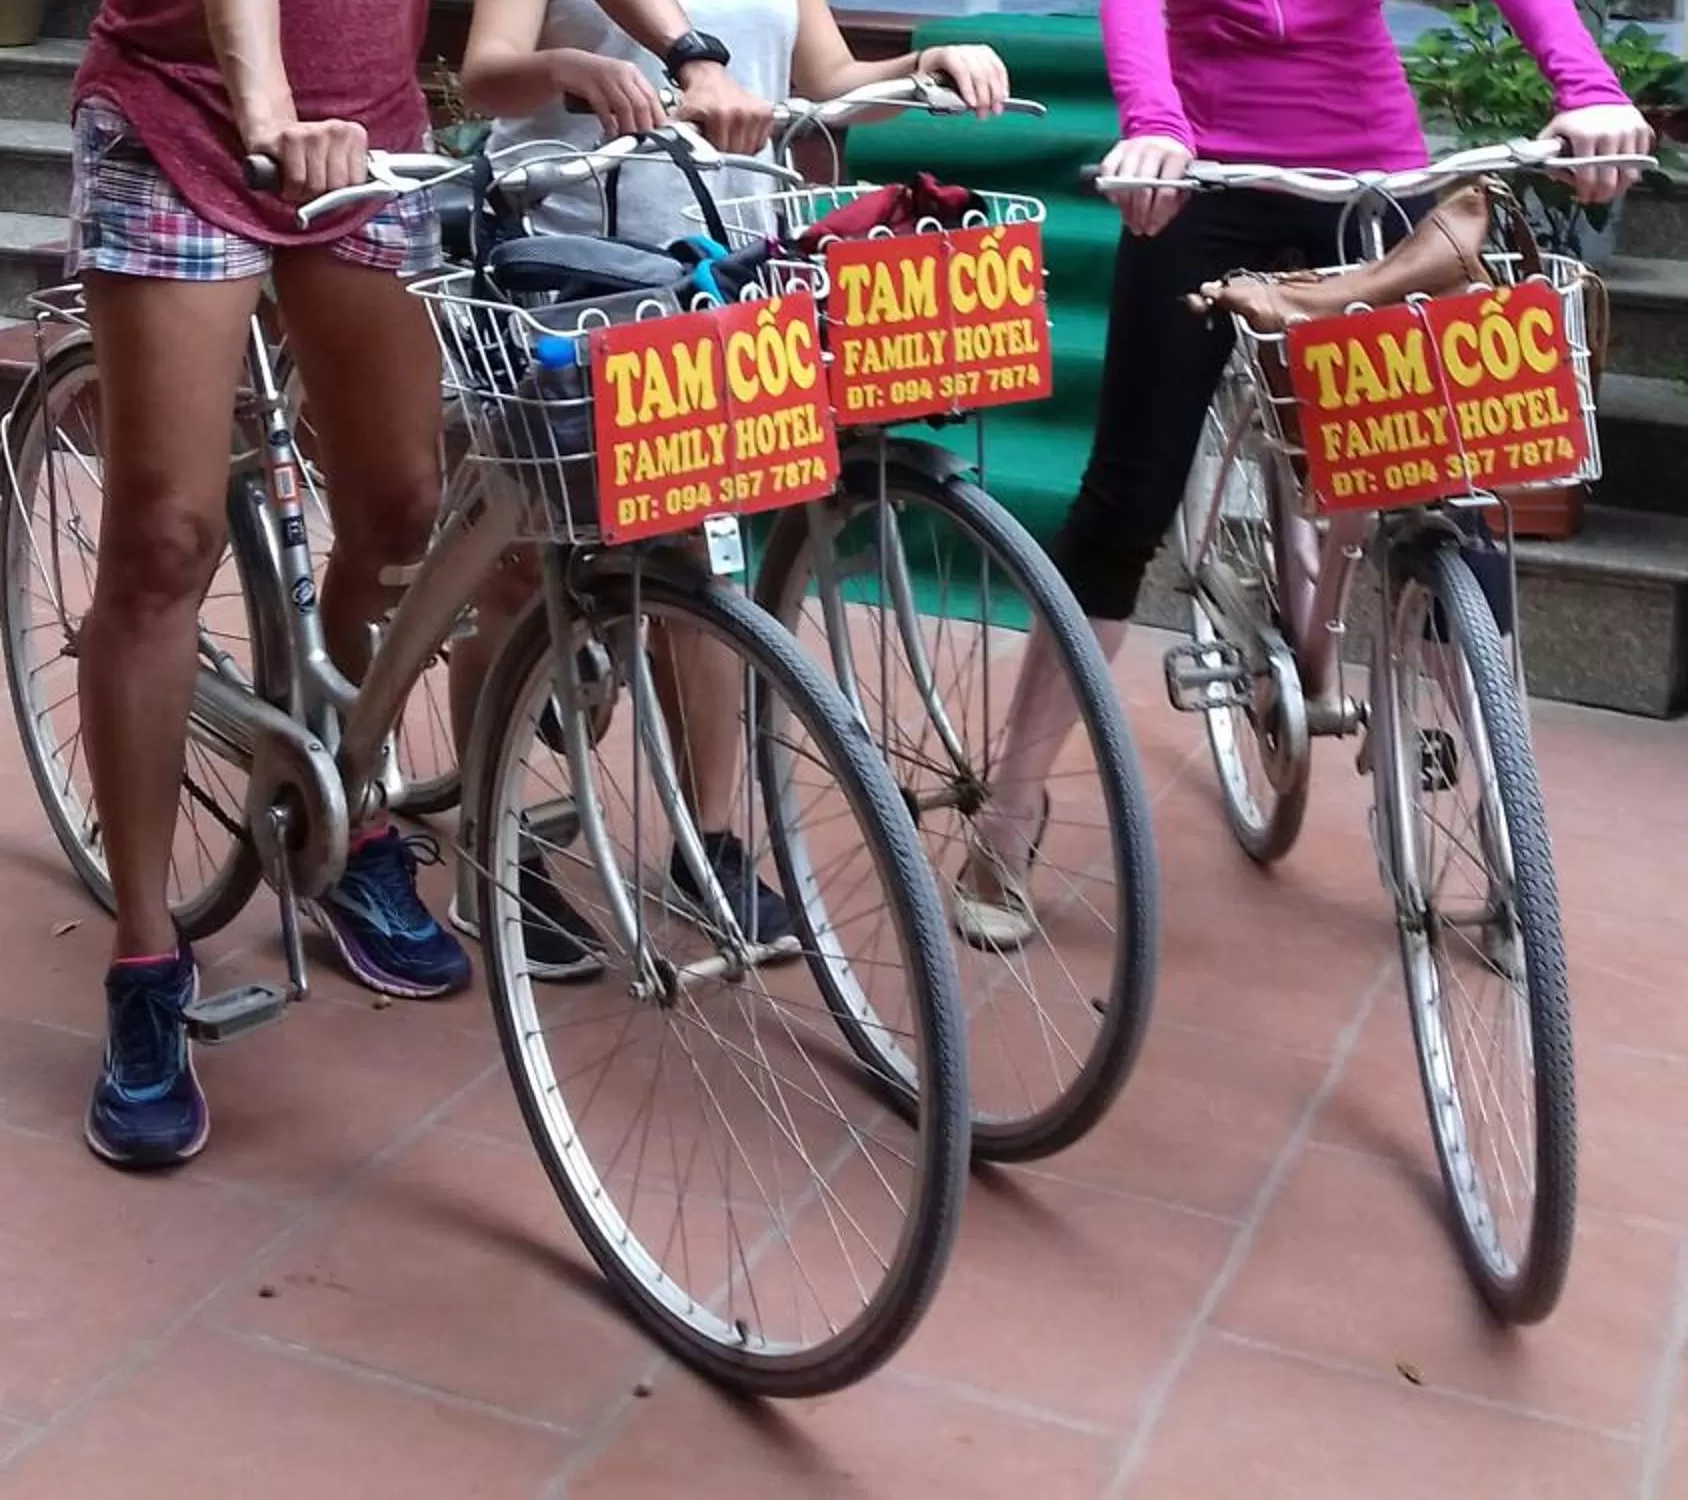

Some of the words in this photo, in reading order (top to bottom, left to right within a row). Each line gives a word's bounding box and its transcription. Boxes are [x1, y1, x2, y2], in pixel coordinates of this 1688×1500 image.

[838, 256, 939, 327] TAM
[948, 226, 1035, 313] CỐC
[605, 338, 717, 428] TAM
[725, 297, 816, 403] CỐC
[843, 330, 947, 377] FAMILY
[954, 318, 1040, 362] HOTEL
[890, 378, 933, 405] 094
[939, 372, 981, 398] 367
[985, 364, 1040, 391] 7874
[1304, 328, 1434, 409] TAM
[1442, 287, 1558, 388] CỐC
[613, 424, 727, 487] FAMILY
[735, 404, 824, 461] HOTEL
[1320, 405, 1448, 461] FAMILY
[1457, 386, 1569, 441] HOTEL
[666, 482, 712, 515] 094
[719, 469, 764, 503] 367
[769, 457, 827, 492] 7874
[1384, 459, 1438, 490] 094
[1444, 448, 1496, 480] 367
[1503, 436, 1575, 469] 7874
